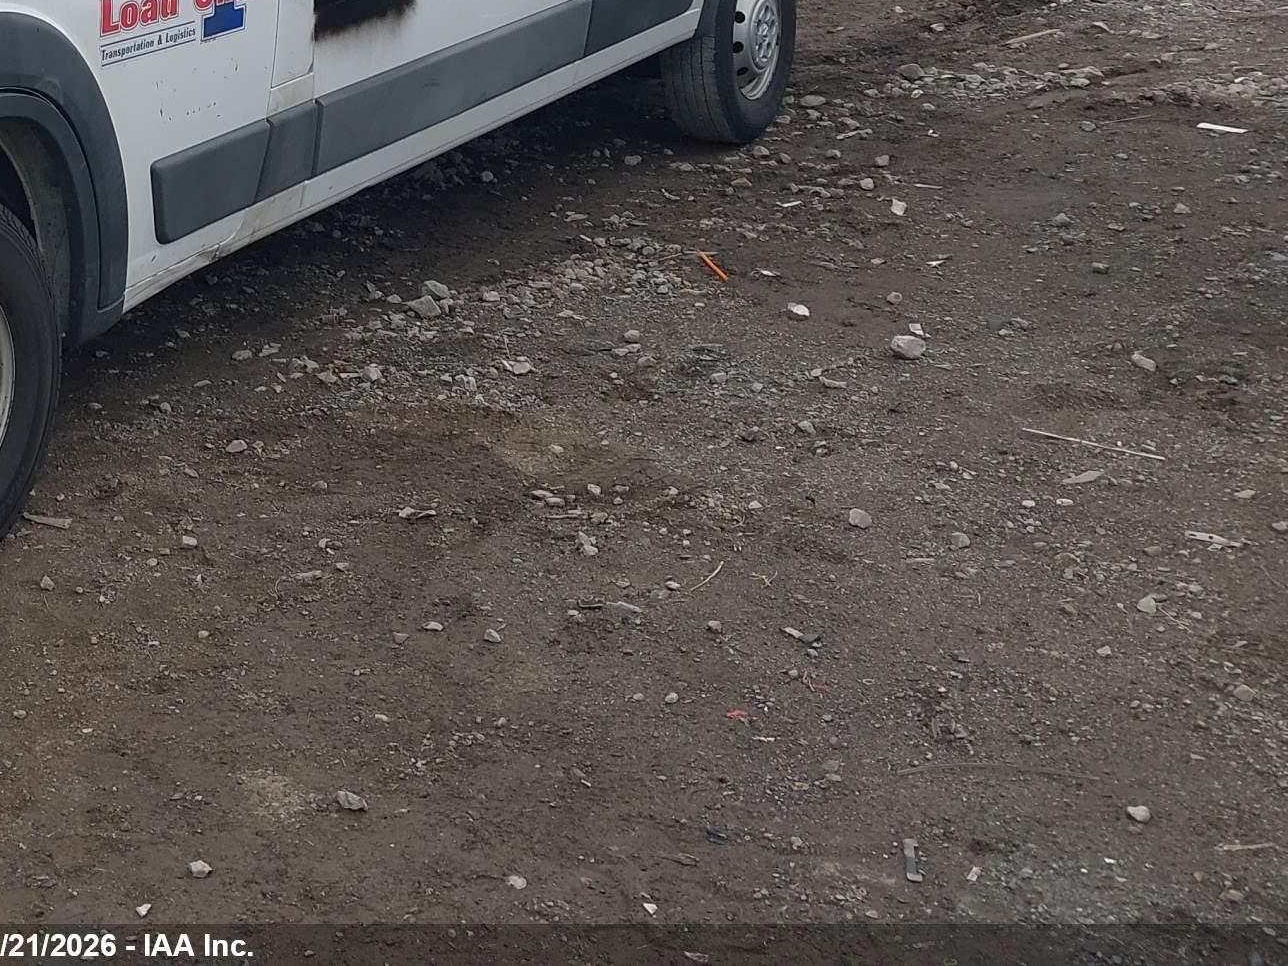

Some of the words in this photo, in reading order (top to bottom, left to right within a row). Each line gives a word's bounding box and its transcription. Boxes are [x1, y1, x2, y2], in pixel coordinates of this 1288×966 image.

[100, 38, 155, 62] Transportation
[157, 35, 163, 46] &
[165, 29, 197, 44] Logistics
